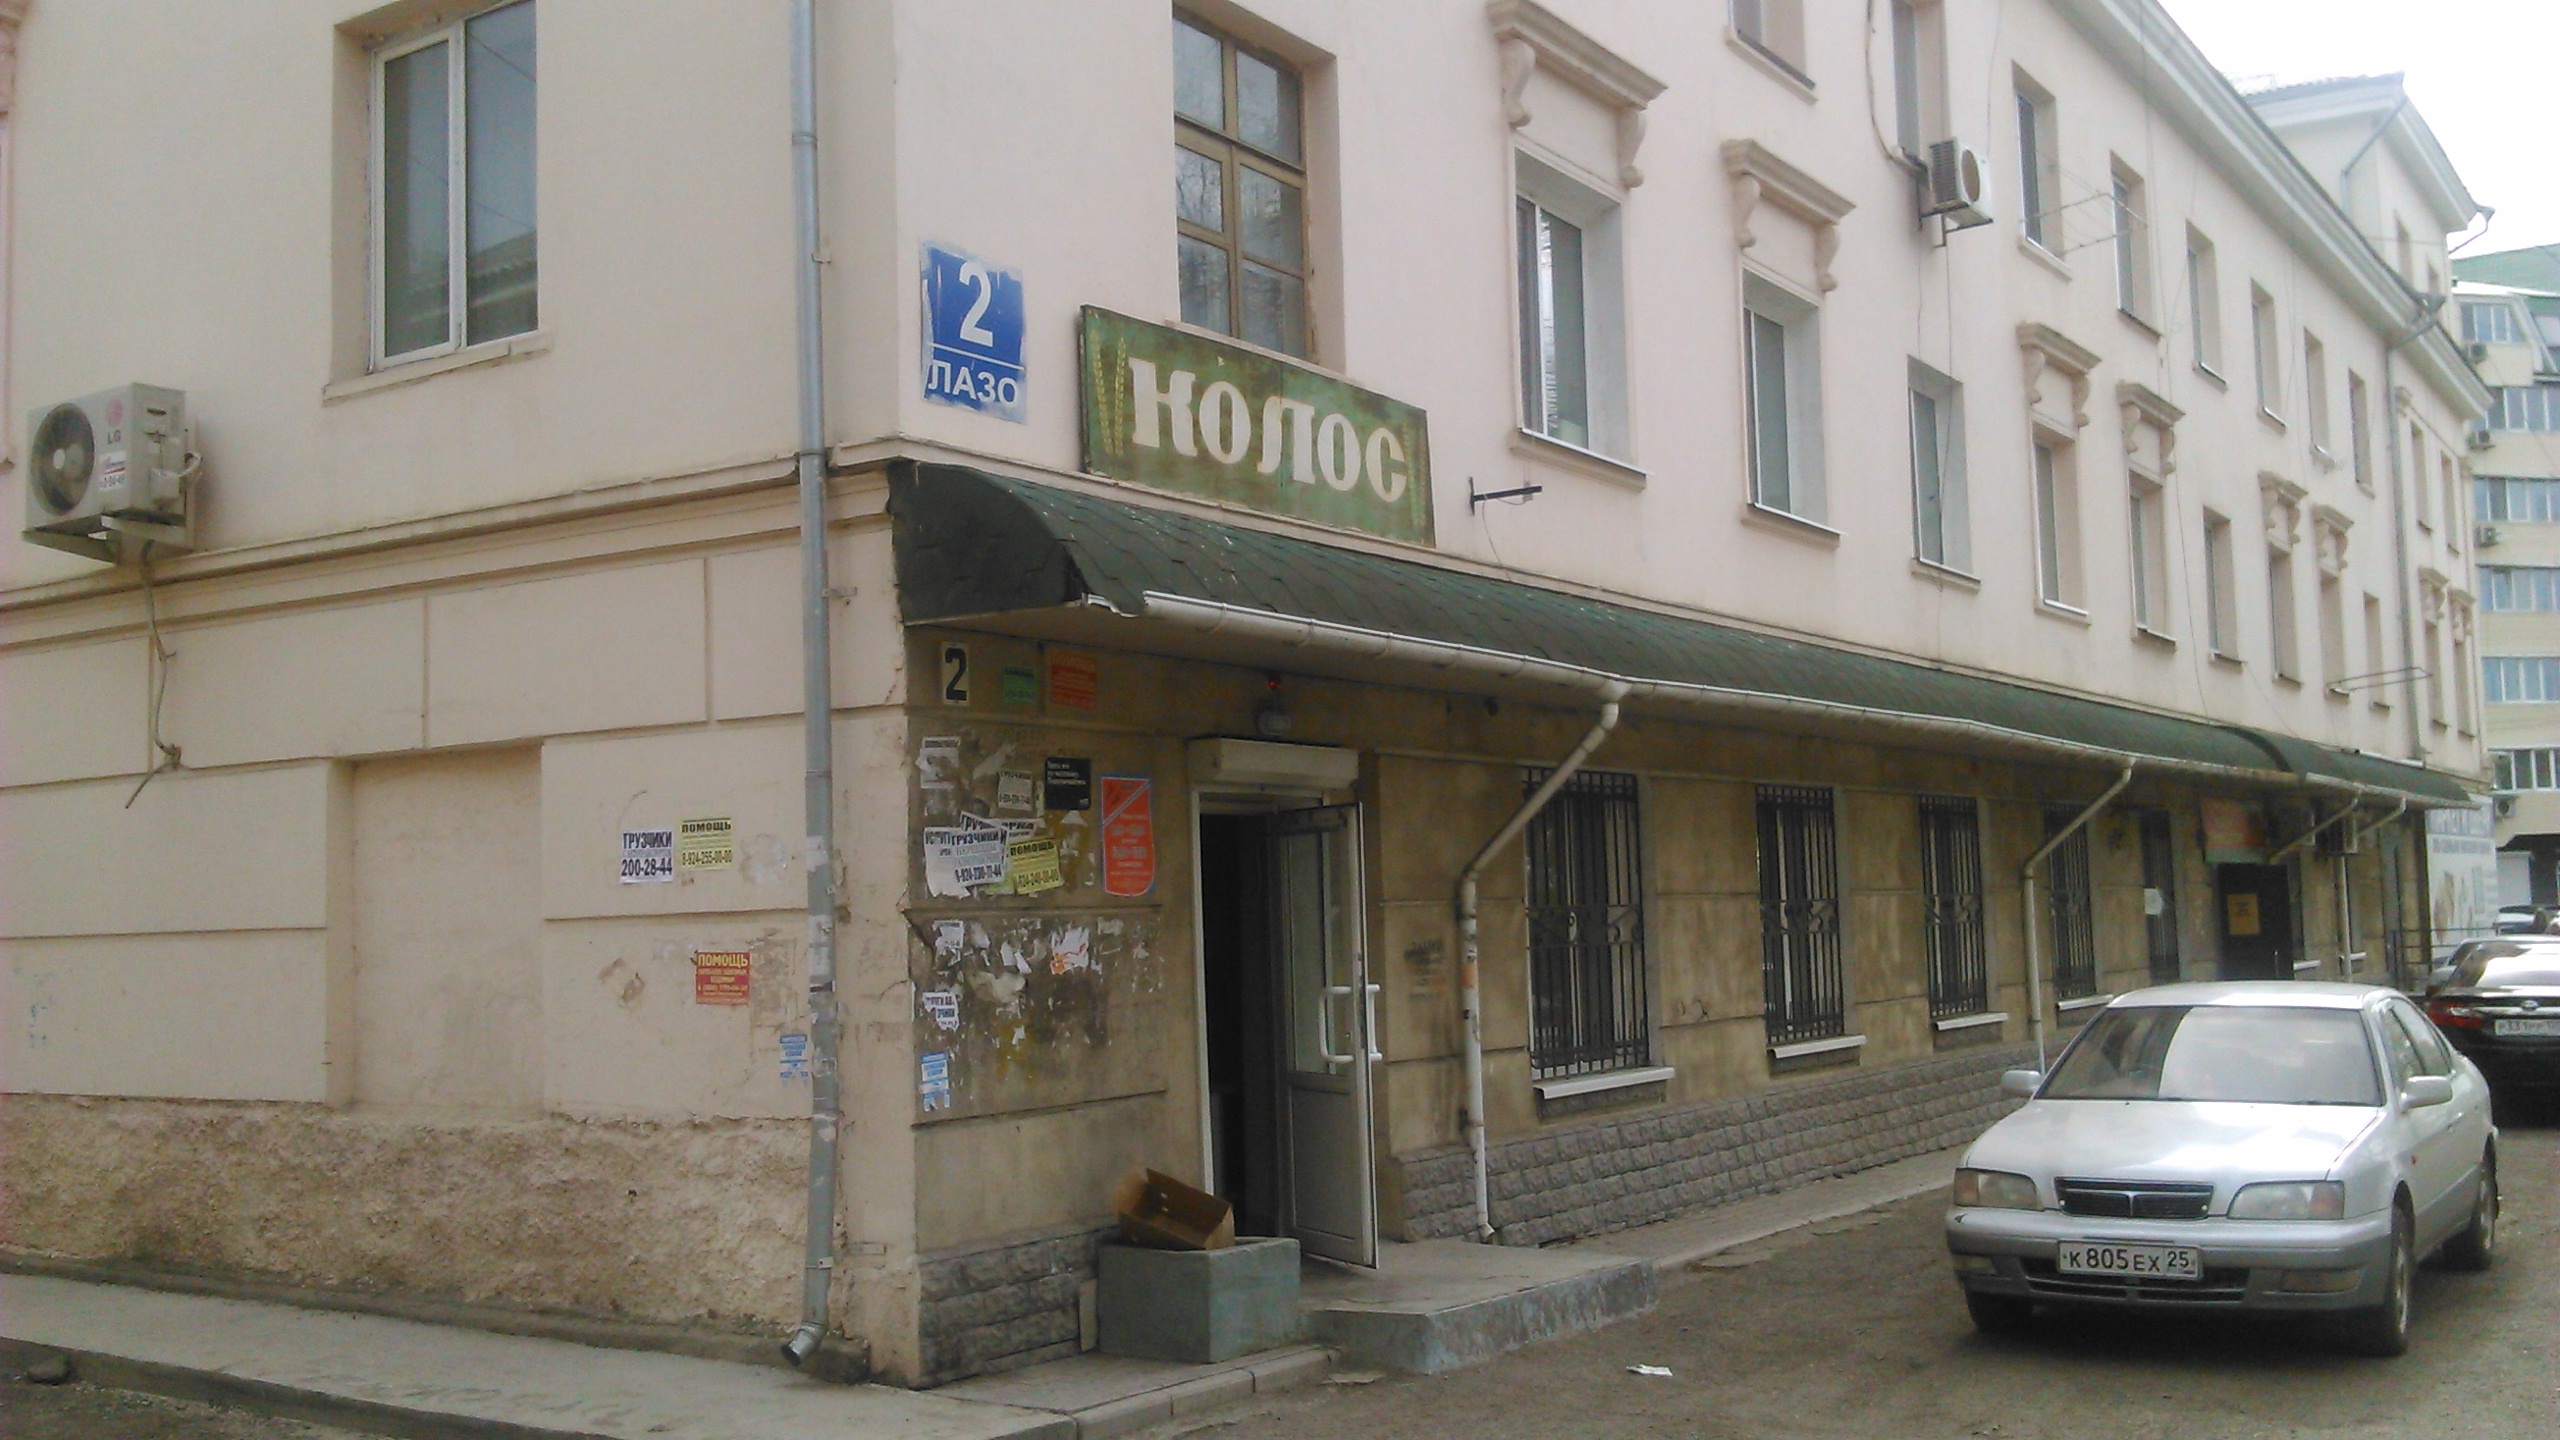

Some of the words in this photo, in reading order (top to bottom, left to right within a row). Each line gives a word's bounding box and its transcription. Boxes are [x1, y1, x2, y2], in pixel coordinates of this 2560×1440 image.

[958, 260, 994, 348] 2
[928, 360, 1020, 408] ЛАЗО
[1129, 355, 1408, 503] КОЛОС
[944, 646, 968, 701] 2
[681, 820, 732, 833] ПОМОЩЬ
[622, 831, 673, 849] ГРУЗЧИКИ
[951, 830, 999, 846] ГРУЗЧИКИ
[1009, 840, 1055, 857] ПОМОЩЬ
[620, 857, 673, 877] 200-28-44
[698, 953, 749, 969] ПОМОЩЬ
[2167, 1250, 2190, 1268] 25
